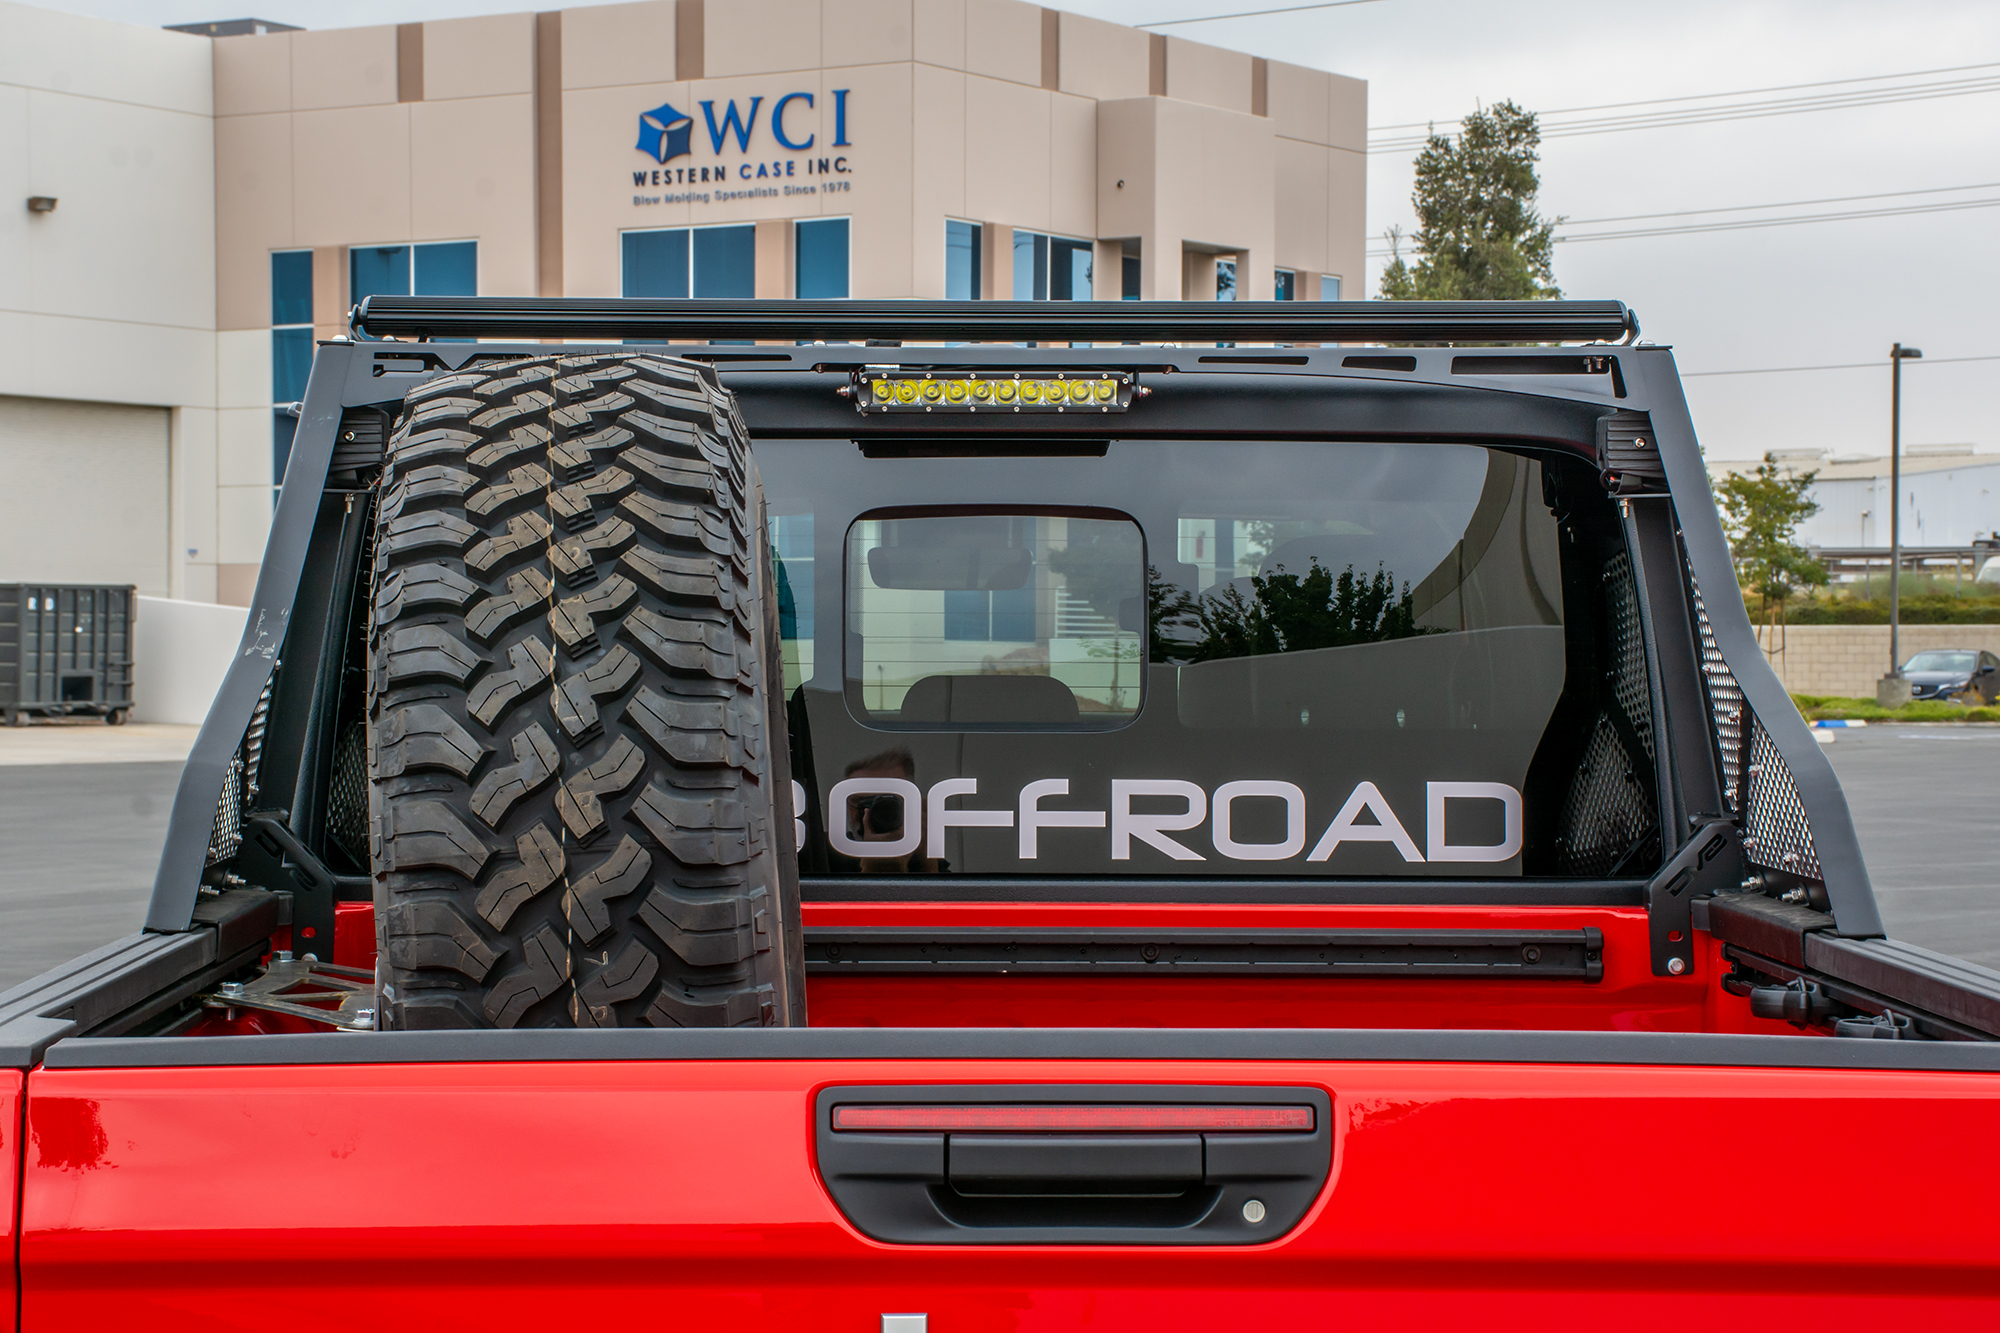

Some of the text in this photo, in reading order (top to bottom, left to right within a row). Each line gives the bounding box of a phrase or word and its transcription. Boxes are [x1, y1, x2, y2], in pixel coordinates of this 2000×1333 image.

[698, 89, 852, 156] WCI
[633, 156, 853, 188] WESTERN CASE INC.
[633, 181, 851, 206] Blow Molding Specialists Since 1978
[828, 777, 1524, 863] OFFROAD
